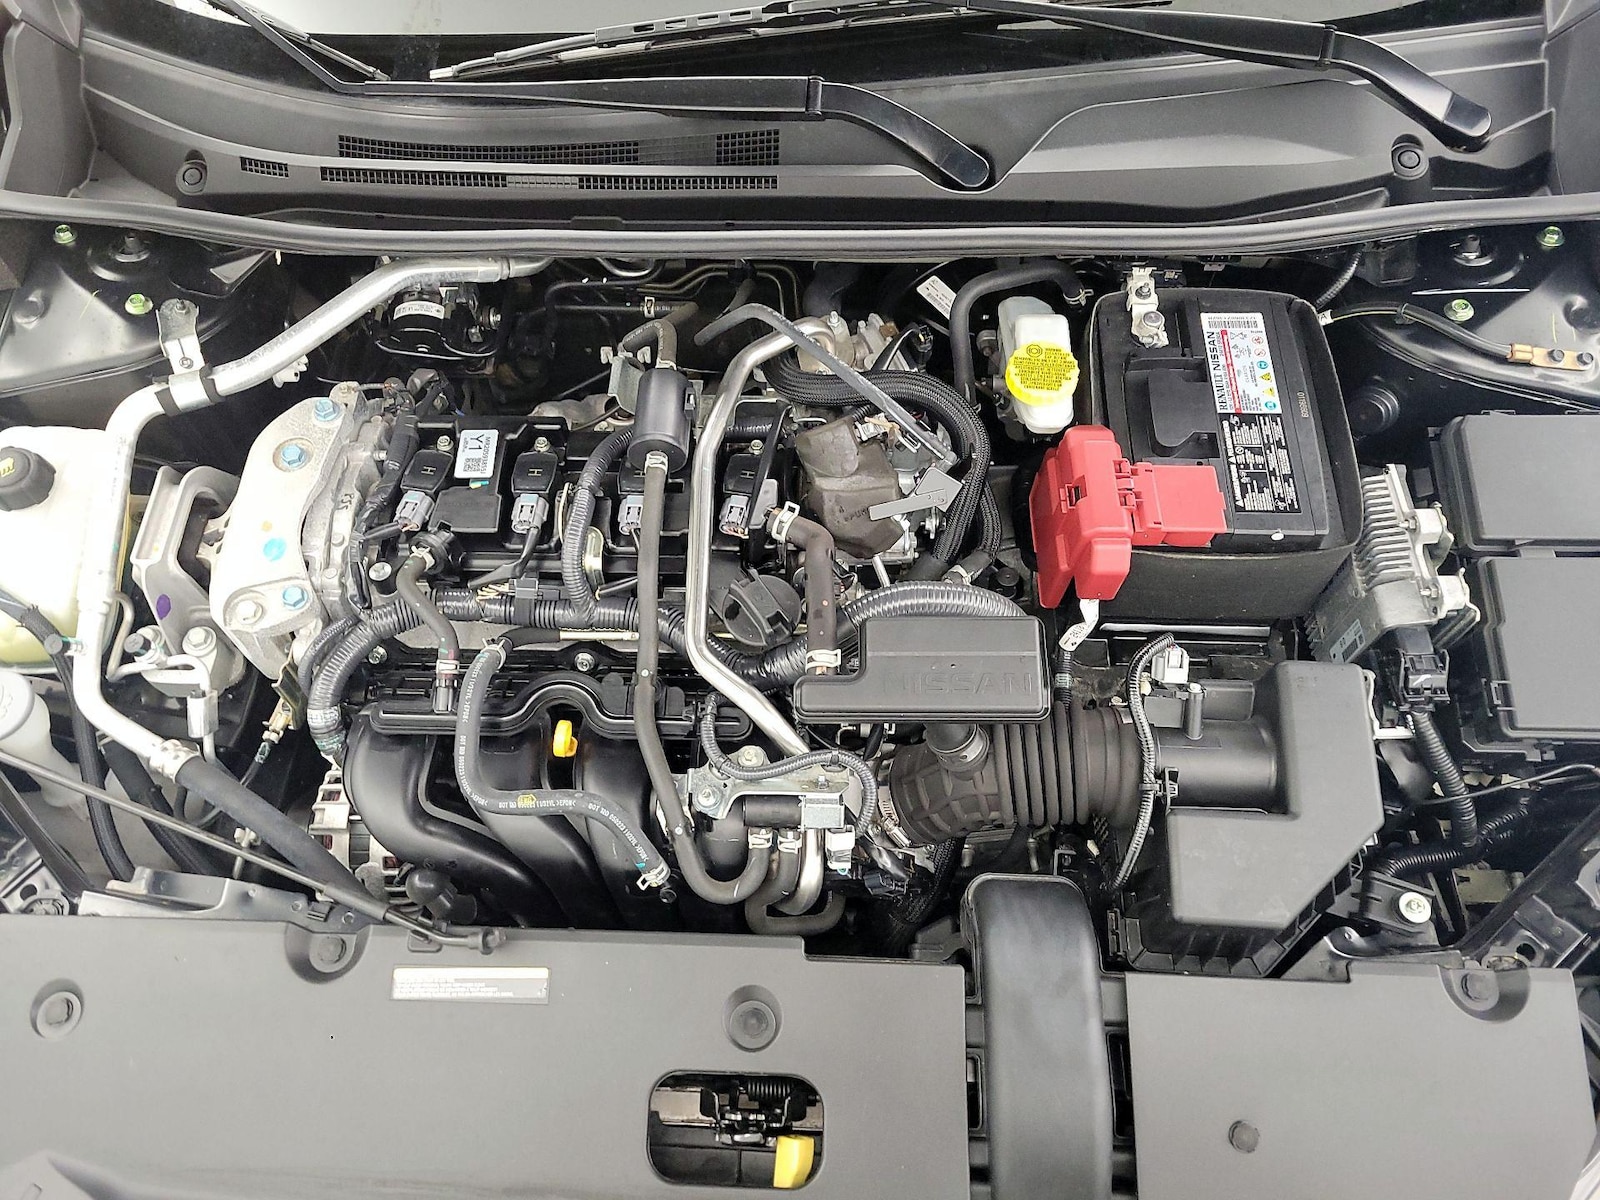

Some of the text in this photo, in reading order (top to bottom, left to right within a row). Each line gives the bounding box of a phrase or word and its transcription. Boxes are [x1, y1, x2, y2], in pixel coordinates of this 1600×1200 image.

[1206, 331, 1221, 371] NISSAN
[1213, 373, 1229, 411] RENAULT
[468, 434, 485, 450] Y1
[883, 672, 1033, 695] NISSAN
